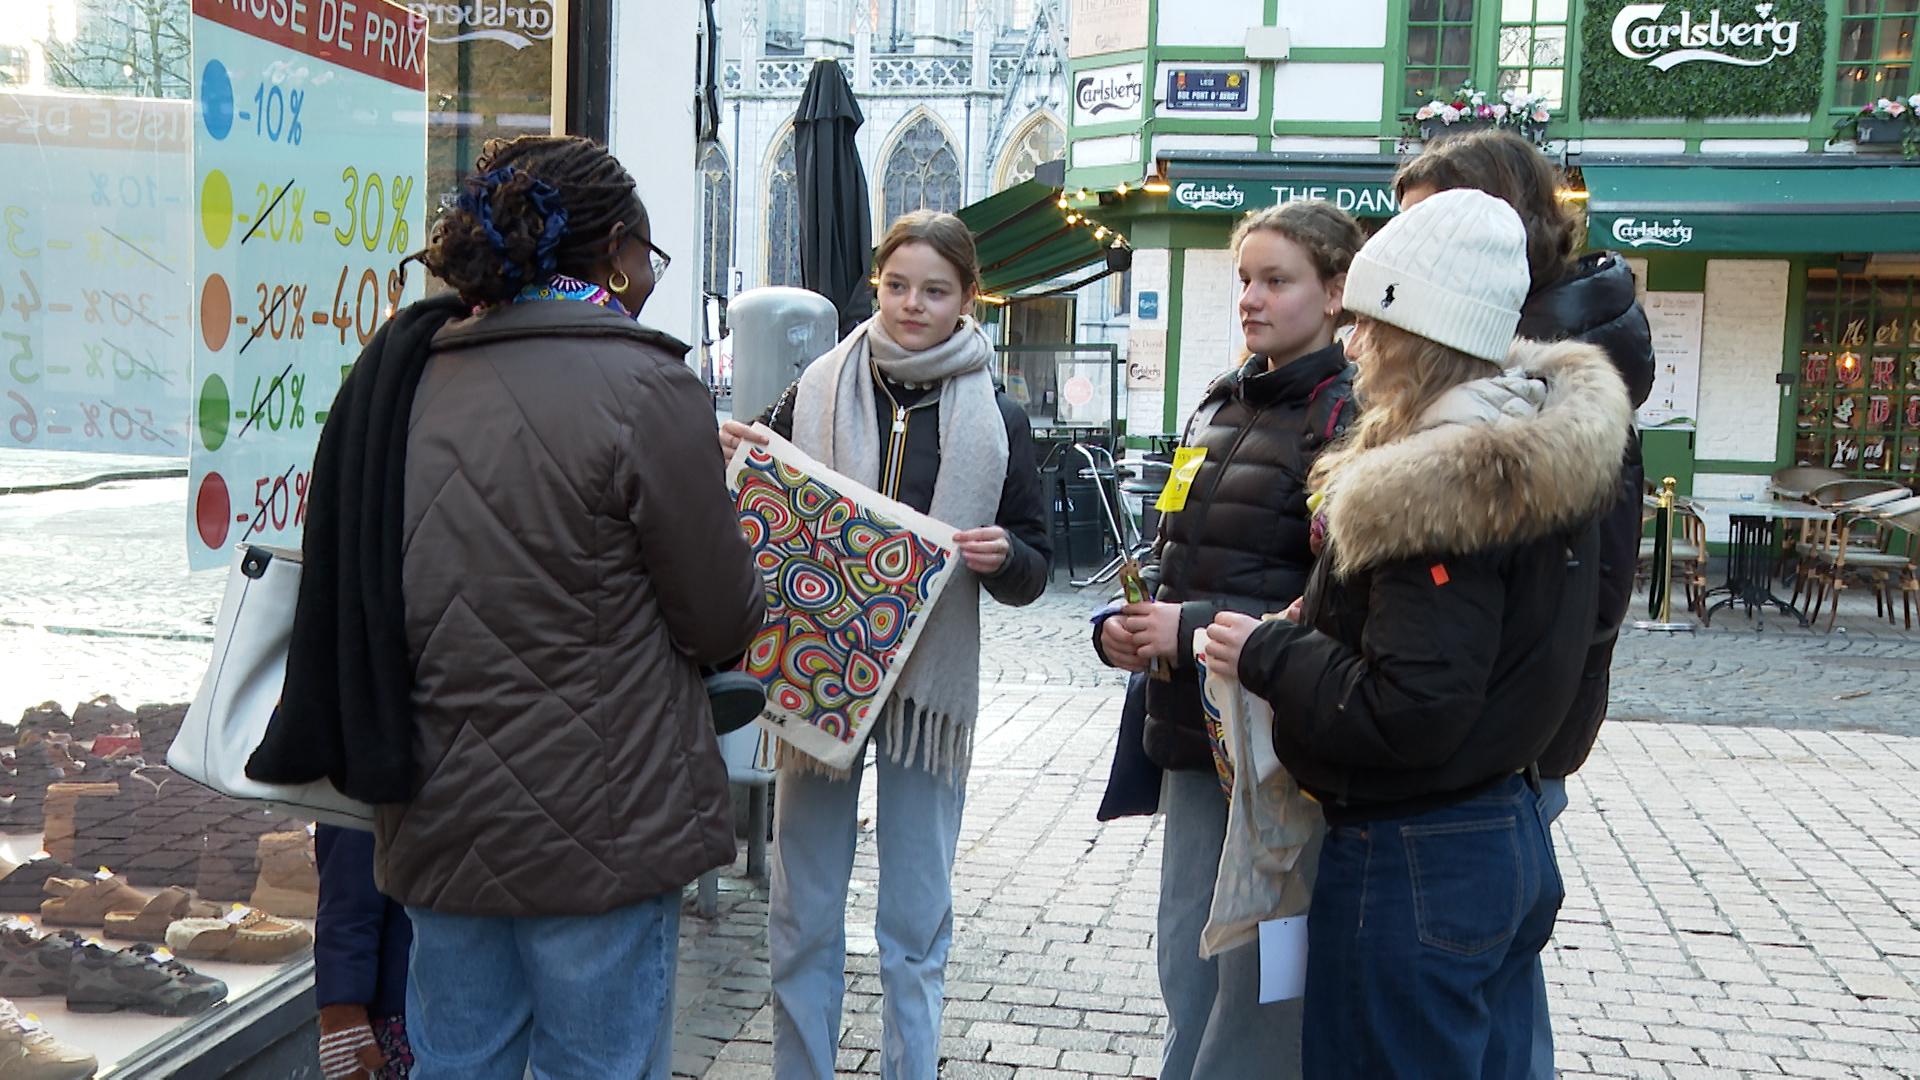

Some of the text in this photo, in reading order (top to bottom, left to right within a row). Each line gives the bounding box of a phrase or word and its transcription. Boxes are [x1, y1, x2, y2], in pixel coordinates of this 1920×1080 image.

[318, 0, 357, 51] DE
[363, 11, 424, 74] PRIX
[1611, 3, 1801, 71] Carlsberg
[238, 82, 304, 146] -10%
[1076, 73, 1142, 115] Carlsberg
[1191, 90, 1209, 100] PONT
[237, 166, 413, 254] -20% -30%
[1175, 182, 1244, 209] Carlsberg
[1271, 186, 1403, 212] THE DAN
[1612, 217, 1693, 247] Carlsberg
[235, 282, 307, 341] -30%
[235, 372, 306, 432] -40%
[236, 471, 310, 534] -50%
